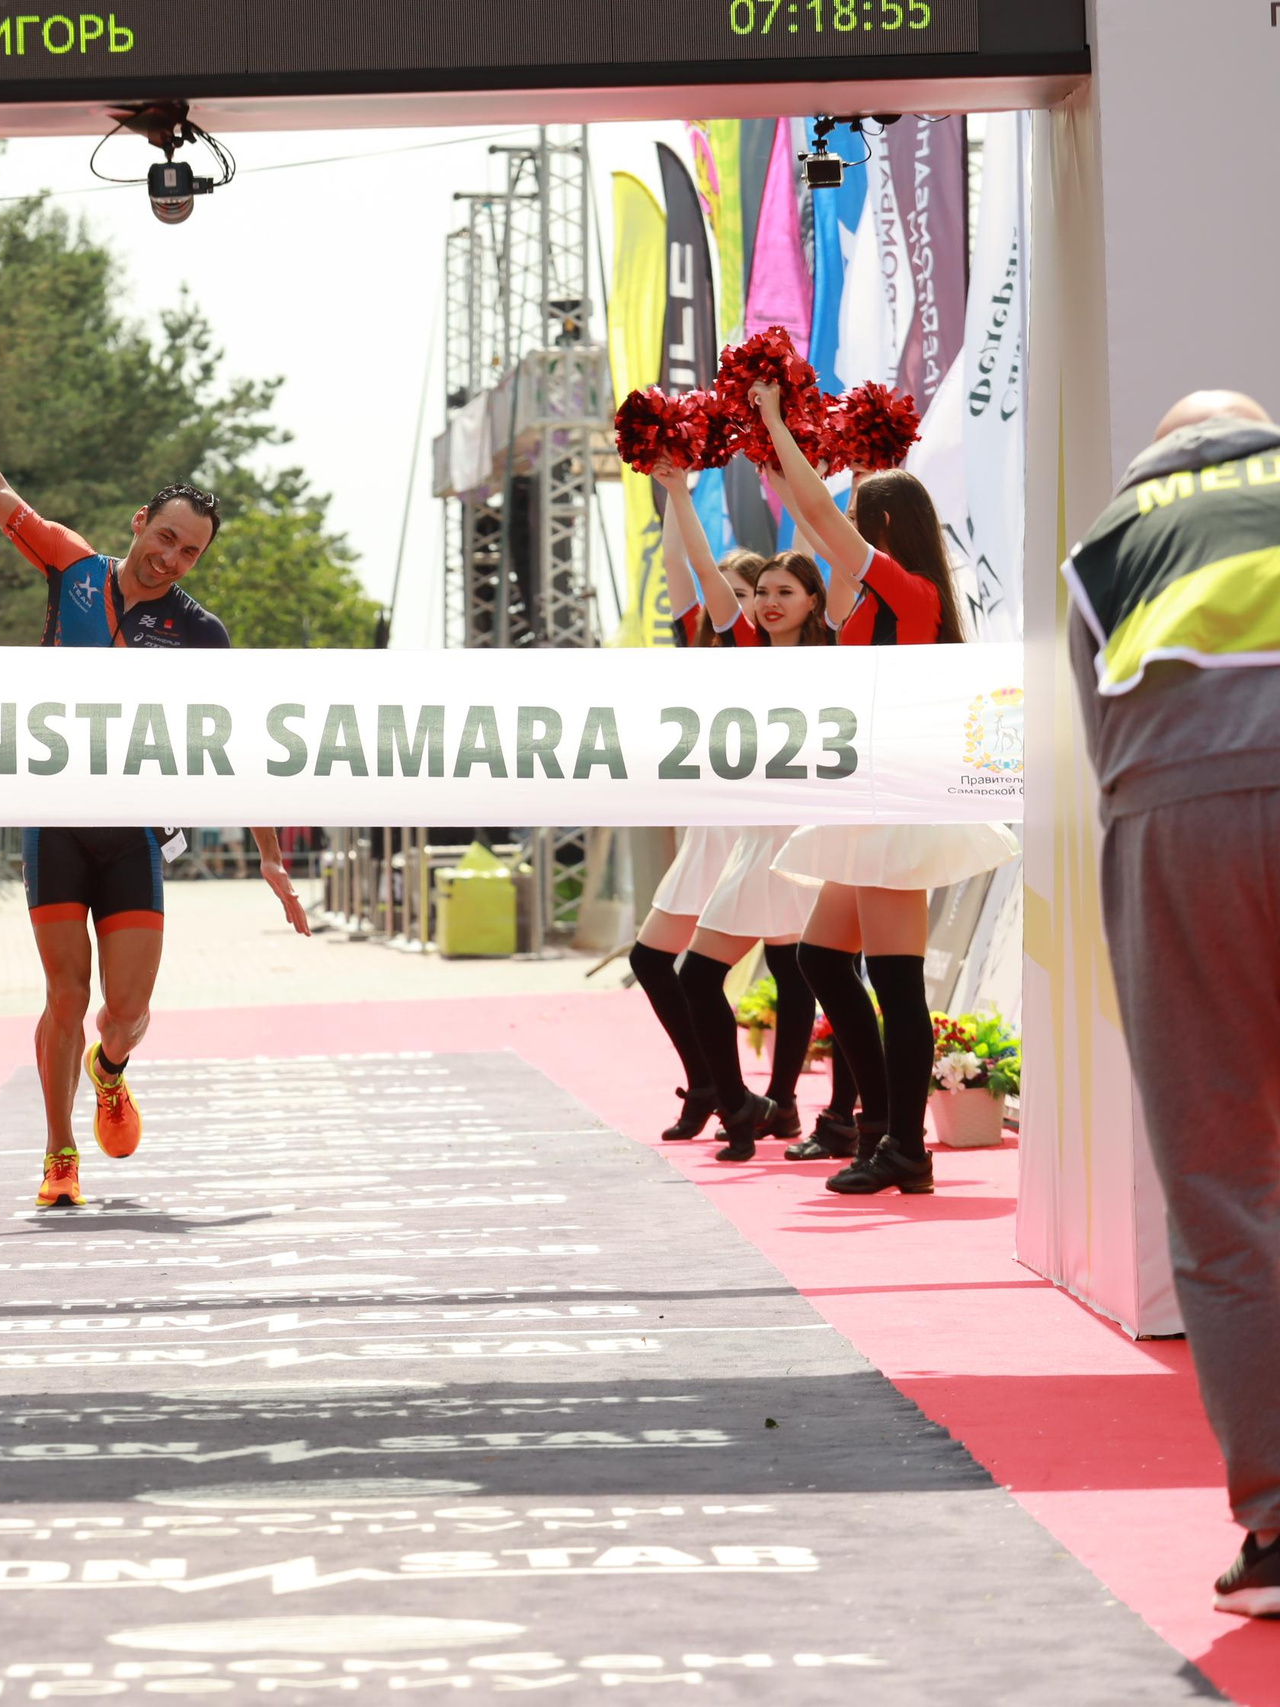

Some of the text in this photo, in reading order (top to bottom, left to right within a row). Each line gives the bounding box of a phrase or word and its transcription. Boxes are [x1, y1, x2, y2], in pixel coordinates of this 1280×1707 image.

[729, 0, 931, 35] 07:18:55
[266, 703, 628, 779] SAMARA
[658, 706, 859, 781] 2023
[947, 786, 1016, 796] Самарской
[354, 1305, 641, 1320] STAR
[376, 1428, 732, 1448] STAR
[398, 1544, 817, 1570] STAR
